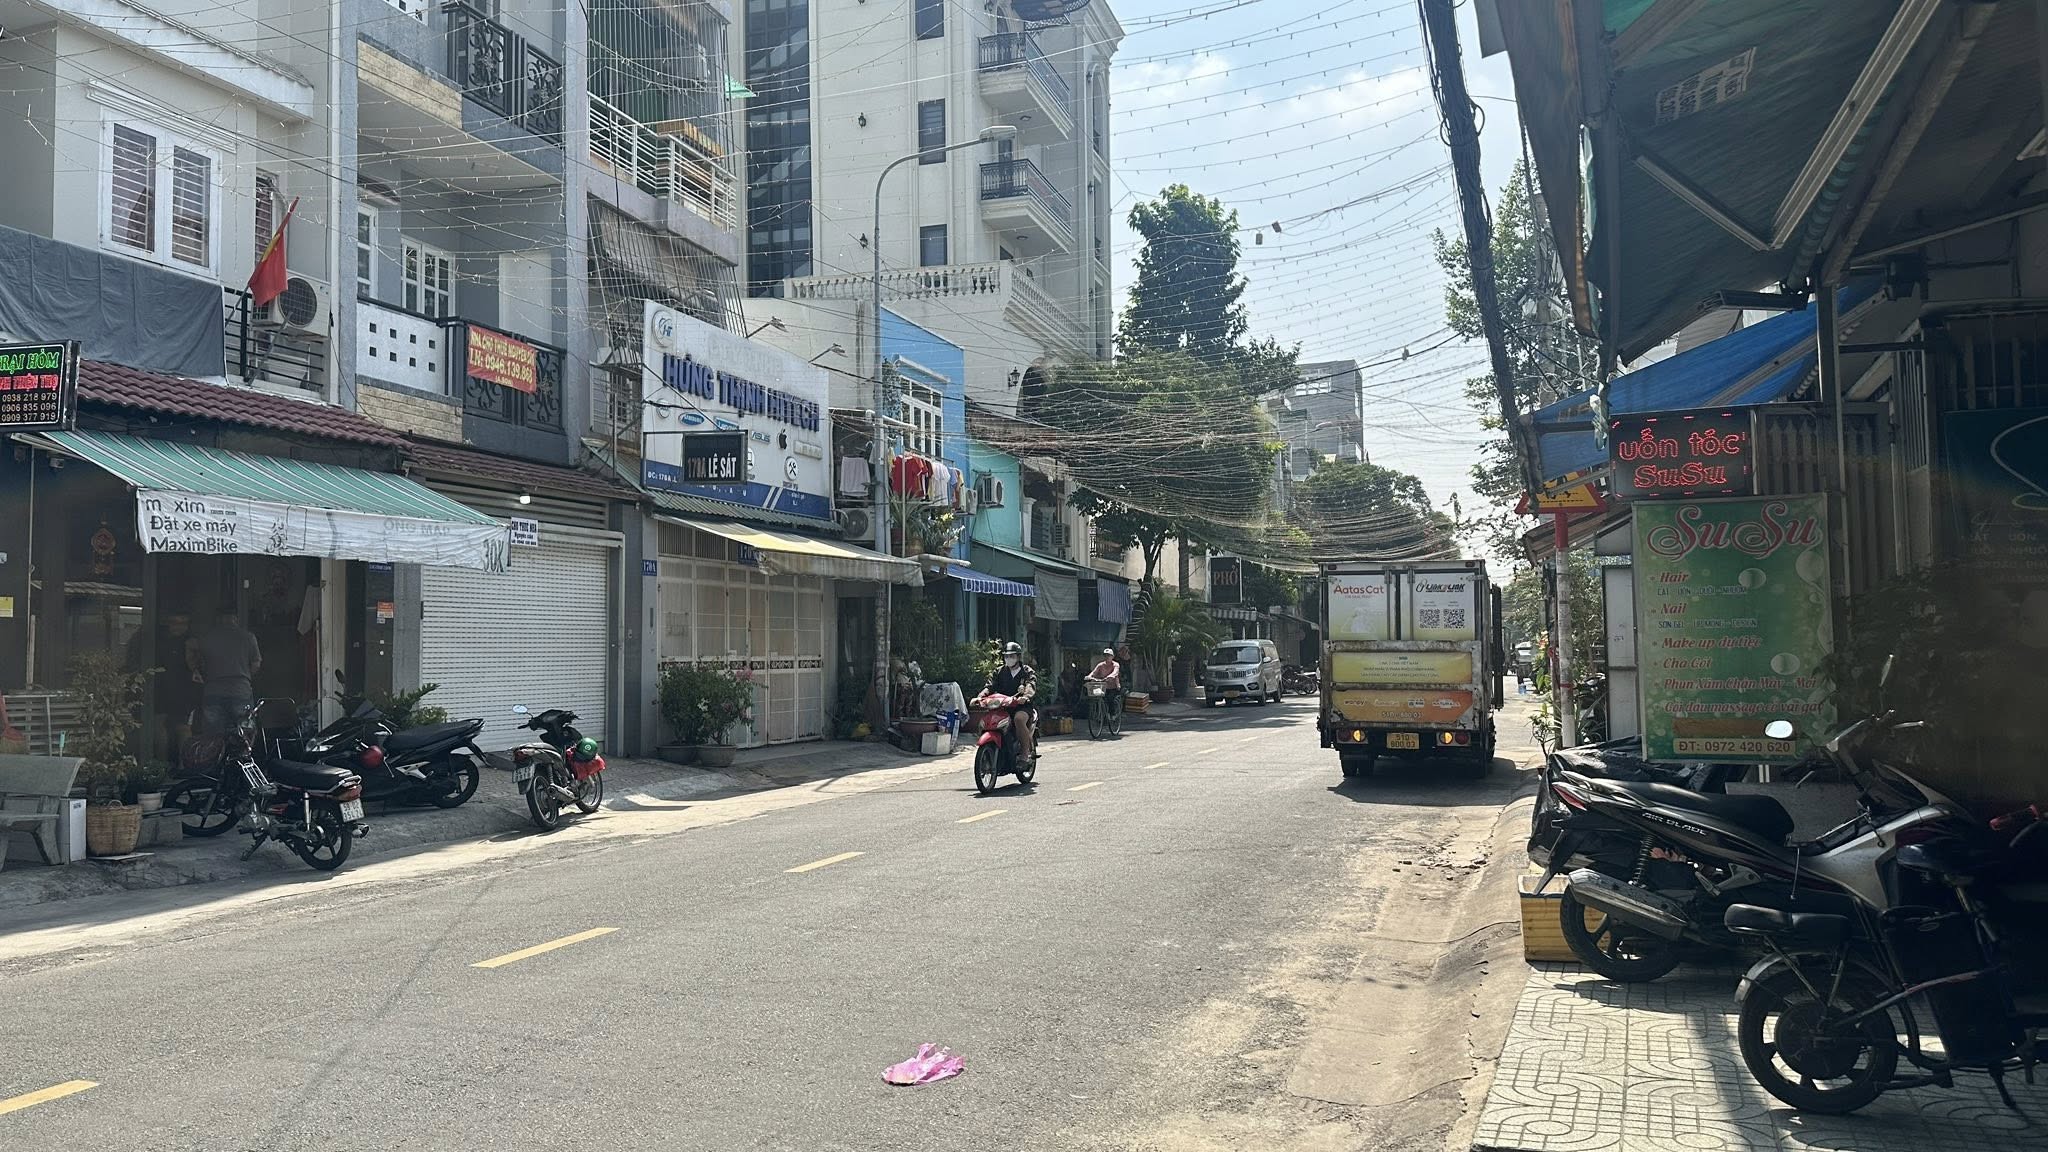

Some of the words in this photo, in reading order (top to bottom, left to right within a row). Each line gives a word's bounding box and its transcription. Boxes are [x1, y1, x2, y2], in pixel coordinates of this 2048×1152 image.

[23, 392, 39, 402] 218
[41, 392, 57, 401] 979
[23, 403, 38, 411] 835
[40, 403, 57, 411] 096
[23, 413, 38, 421] 377
[40, 412, 57, 421] 919
[708, 453, 719, 478] LÊ
[720, 452, 737, 478] SÁT
[1633, 462, 1728, 488] SuSu
[150, 515, 179, 534] Đặt
[183, 520, 202, 531] xe
[206, 518, 237, 536] máy
[150, 537, 238, 553] MaximBike
[1213, 565, 1239, 586] PHỞ
[1660, 572, 1689, 583] Hair
[1660, 602, 1688, 615] Nail
[1662, 637, 1698, 649] Make
[1699, 639, 1715, 650] up
[1664, 678, 1694, 689] Phun
[1678, 741, 1700, 751] ĐT:
[1704, 741, 1736, 752] 0972
[1739, 741, 1763, 752] 420
[1767, 741, 1791, 752] 620
